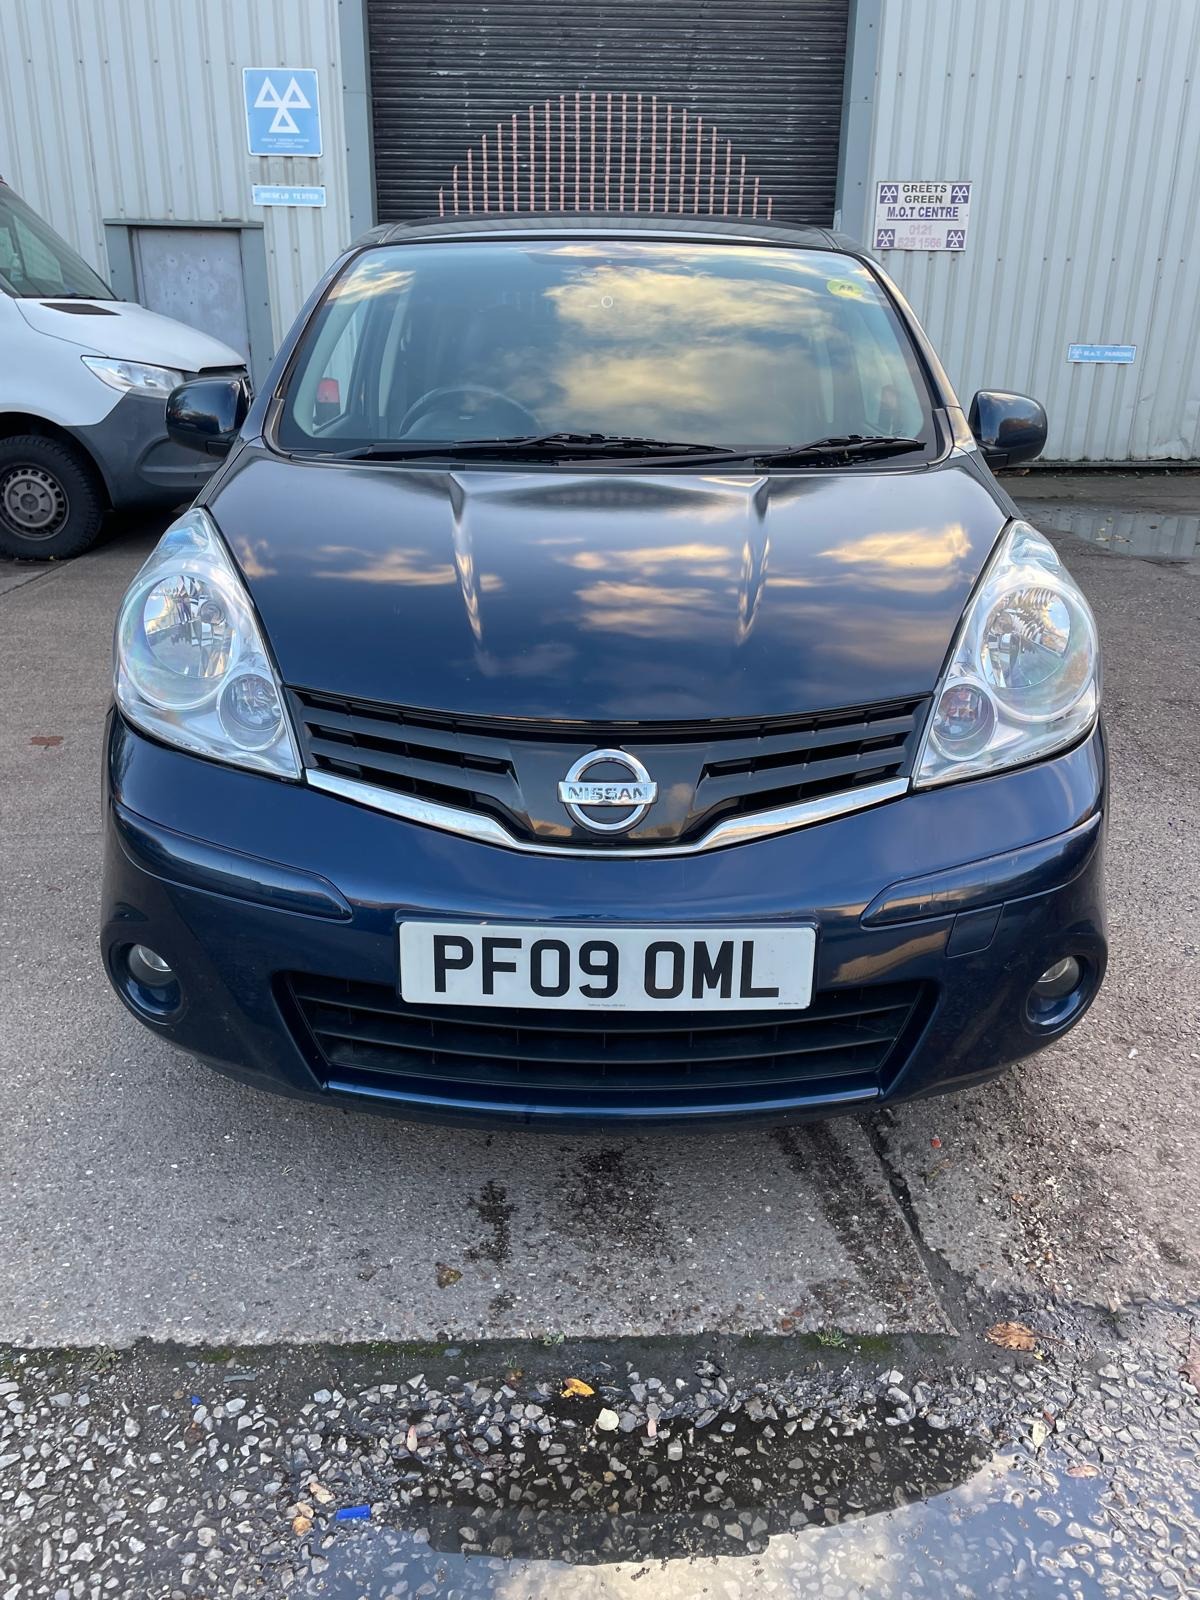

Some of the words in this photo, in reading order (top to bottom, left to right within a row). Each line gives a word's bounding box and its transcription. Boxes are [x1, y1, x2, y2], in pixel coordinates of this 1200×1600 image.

[902, 184, 947, 193] GREETS
[904, 195, 943, 204] GREEN
[887, 206, 916, 218] M.O.T
[918, 206, 959, 218] CENTRE
[568, 786, 648, 801] NISSAN
[433, 934, 620, 999] PF09
[644, 940, 780, 999] OML
